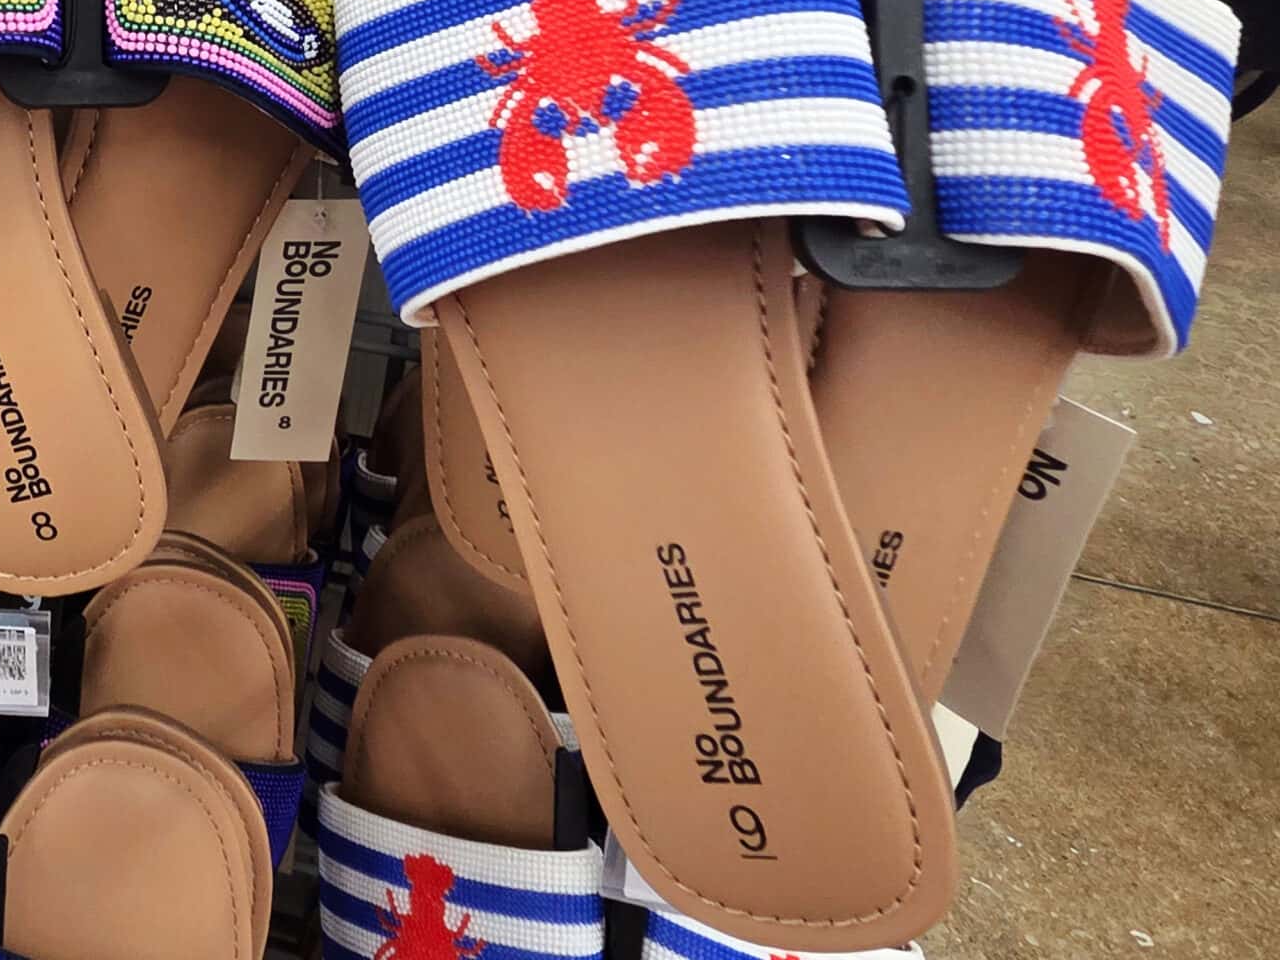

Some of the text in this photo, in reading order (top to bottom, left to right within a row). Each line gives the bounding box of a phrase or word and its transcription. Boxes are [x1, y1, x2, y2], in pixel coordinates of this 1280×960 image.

[308, 240, 342, 277] NO
[258, 241, 312, 408] BOUNDARIES
[278, 416, 291, 430] 8
[4, 467, 31, 503] NO
[1017, 448, 1069, 501] NO
[31, 511, 58, 541] 8
[656, 542, 762, 785] BOUNDARIES
[695, 734, 731, 785] NO
